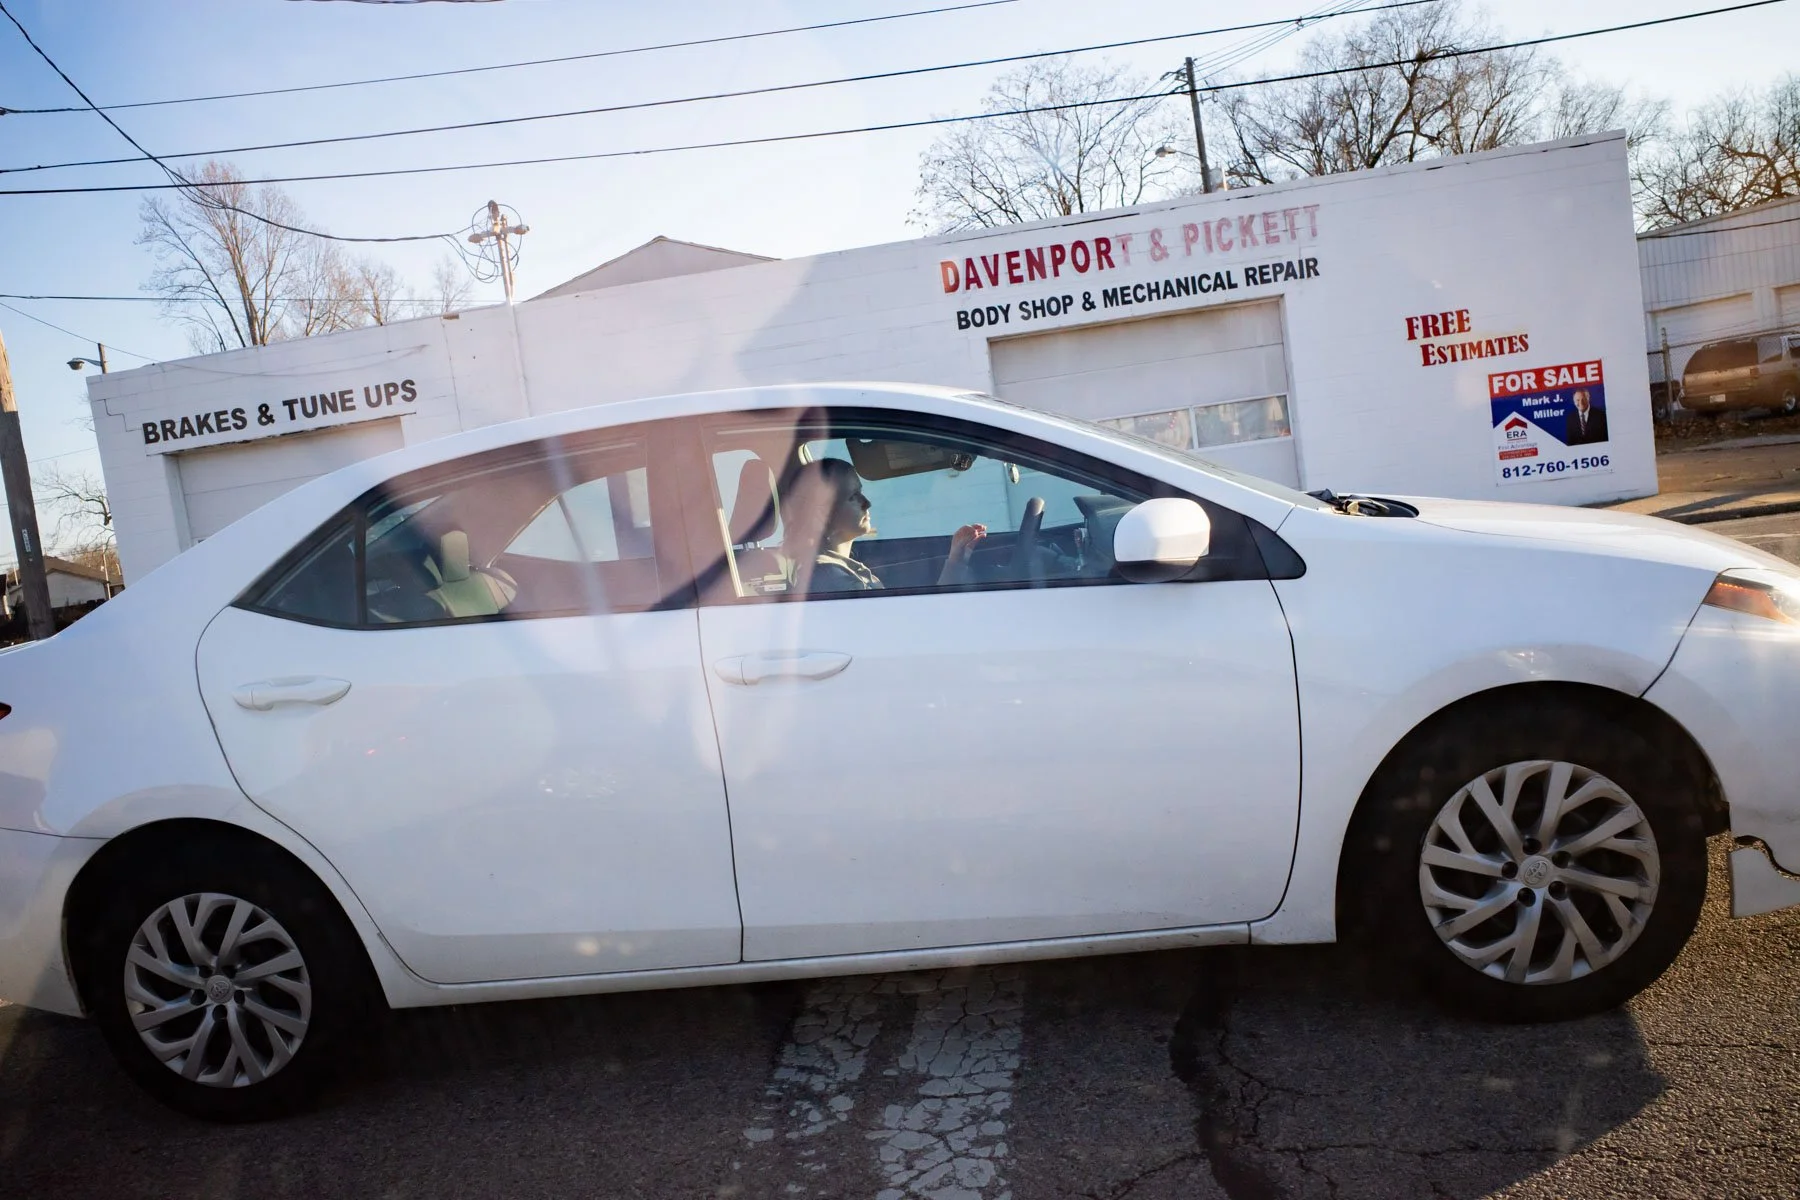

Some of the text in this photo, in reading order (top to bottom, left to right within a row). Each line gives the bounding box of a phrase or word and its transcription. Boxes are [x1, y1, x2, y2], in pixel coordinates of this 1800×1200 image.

[940, 203, 1320, 294] DAVENPORT & PICKETT
[957, 257, 1320, 331] BODY SHOP & MECHANICAL REPAIR
[1405, 309, 1472, 341] FREE
[1492, 364, 1600, 394] FOR SALE
[142, 379, 418, 444] BRAKES & TUNE UPS
[1522, 394, 1564, 407] Mark J.
[1533, 408, 1565, 420] Miller
[1506, 430, 1527, 439] ERA
[1502, 455, 1610, 479] 812-760-1506
